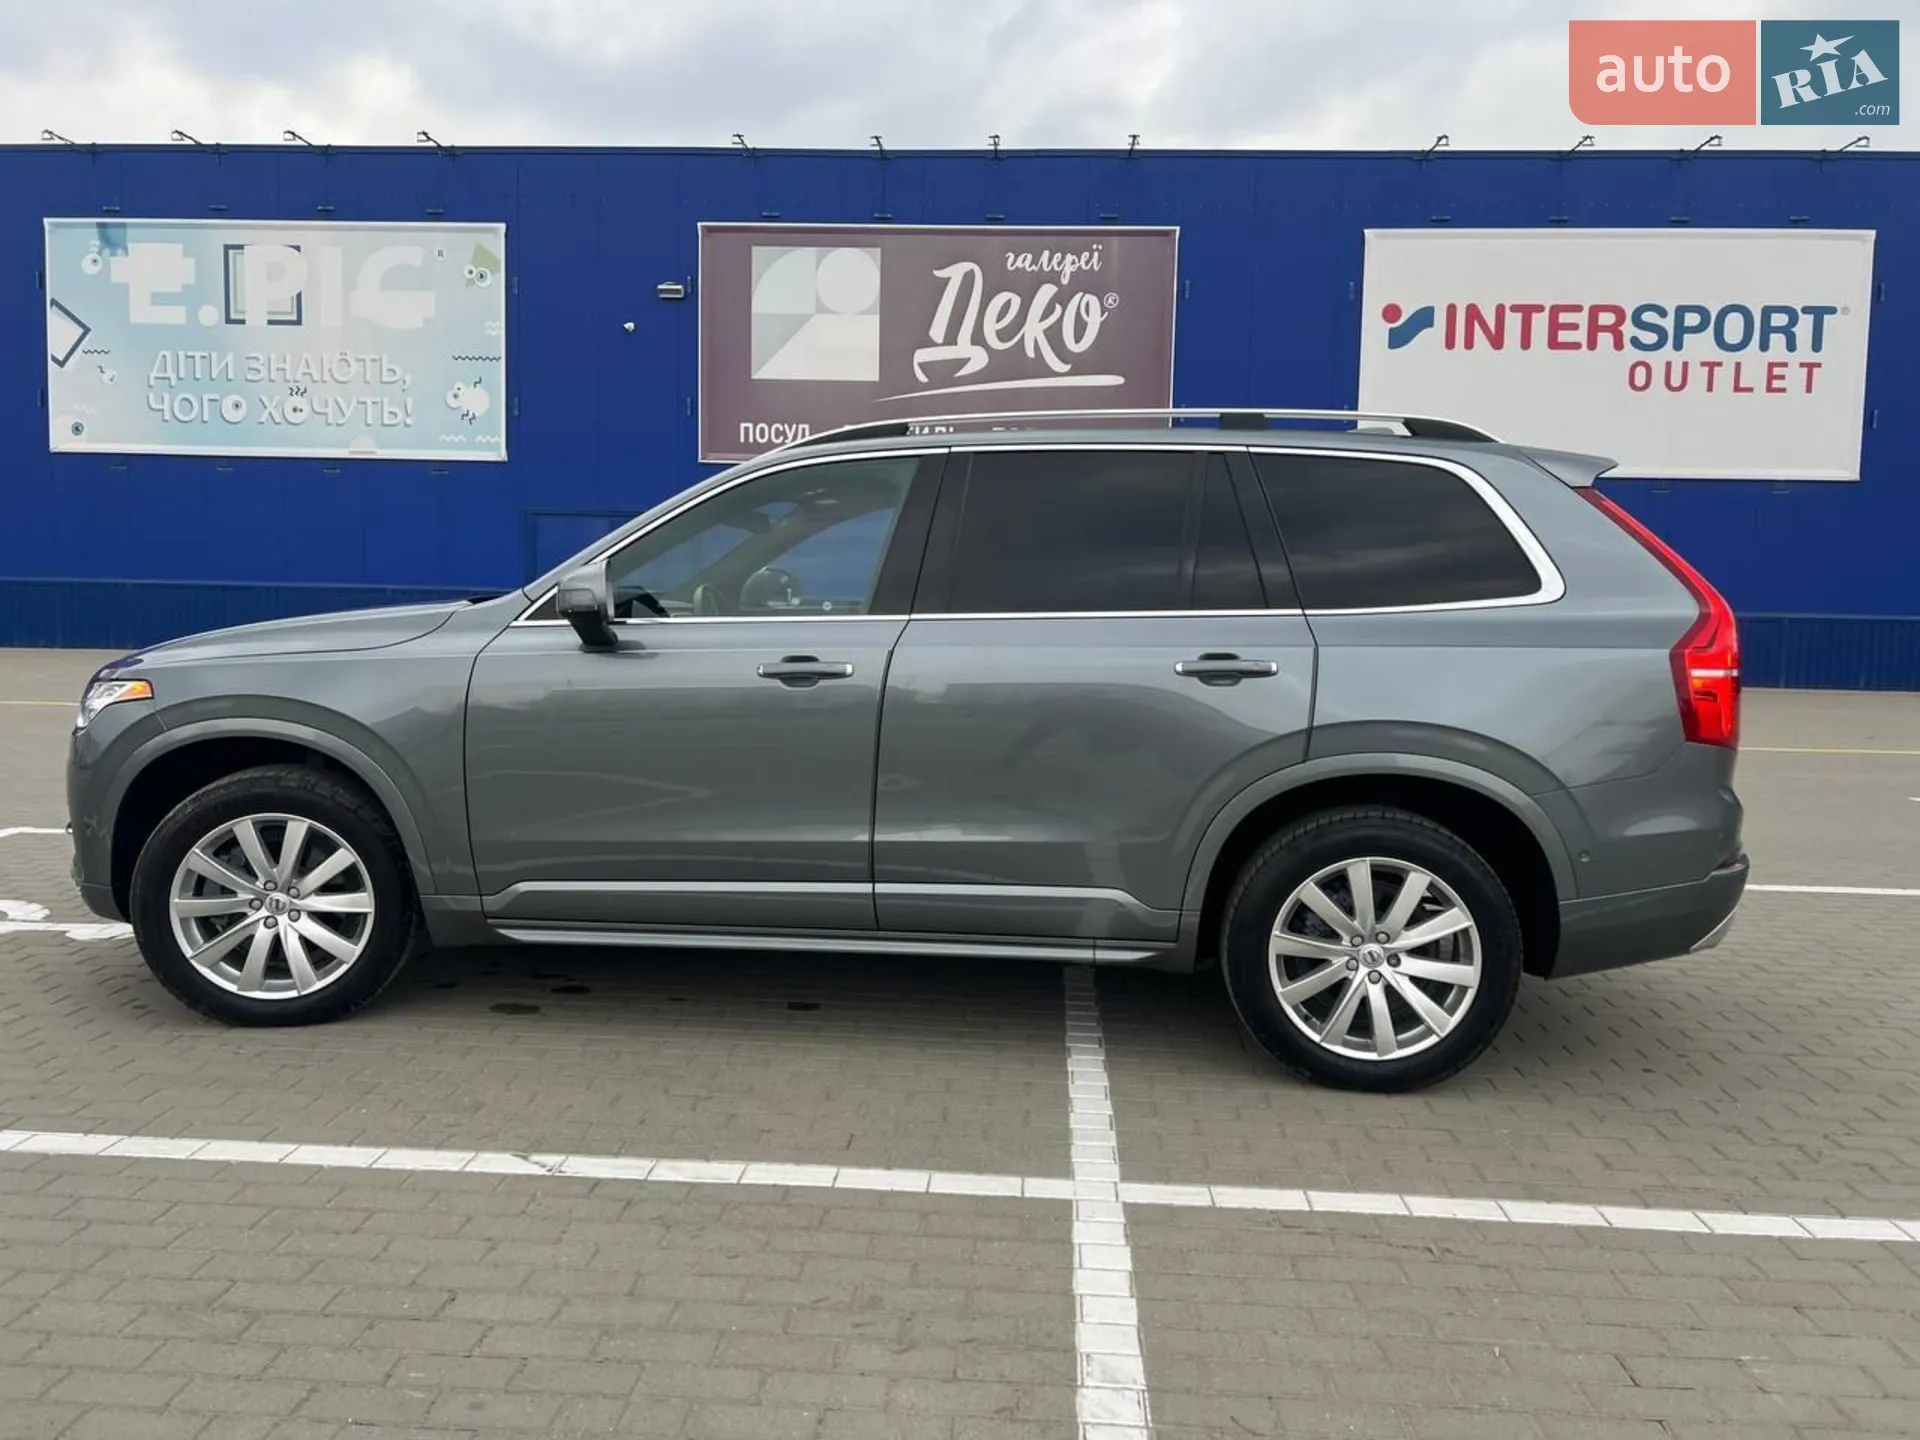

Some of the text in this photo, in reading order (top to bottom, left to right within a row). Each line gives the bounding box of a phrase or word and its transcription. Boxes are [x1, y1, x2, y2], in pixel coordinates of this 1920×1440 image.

[1005, 243, 1102, 285] галереї
[1444, 303, 1838, 353] INTERSPORT
[148, 350, 412, 392] ДІТИ ЗНАЮТЬ,
[1628, 360, 1823, 393] OUTLET
[147, 392, 413, 427] ЧОГО ХОЧУТЬ!
